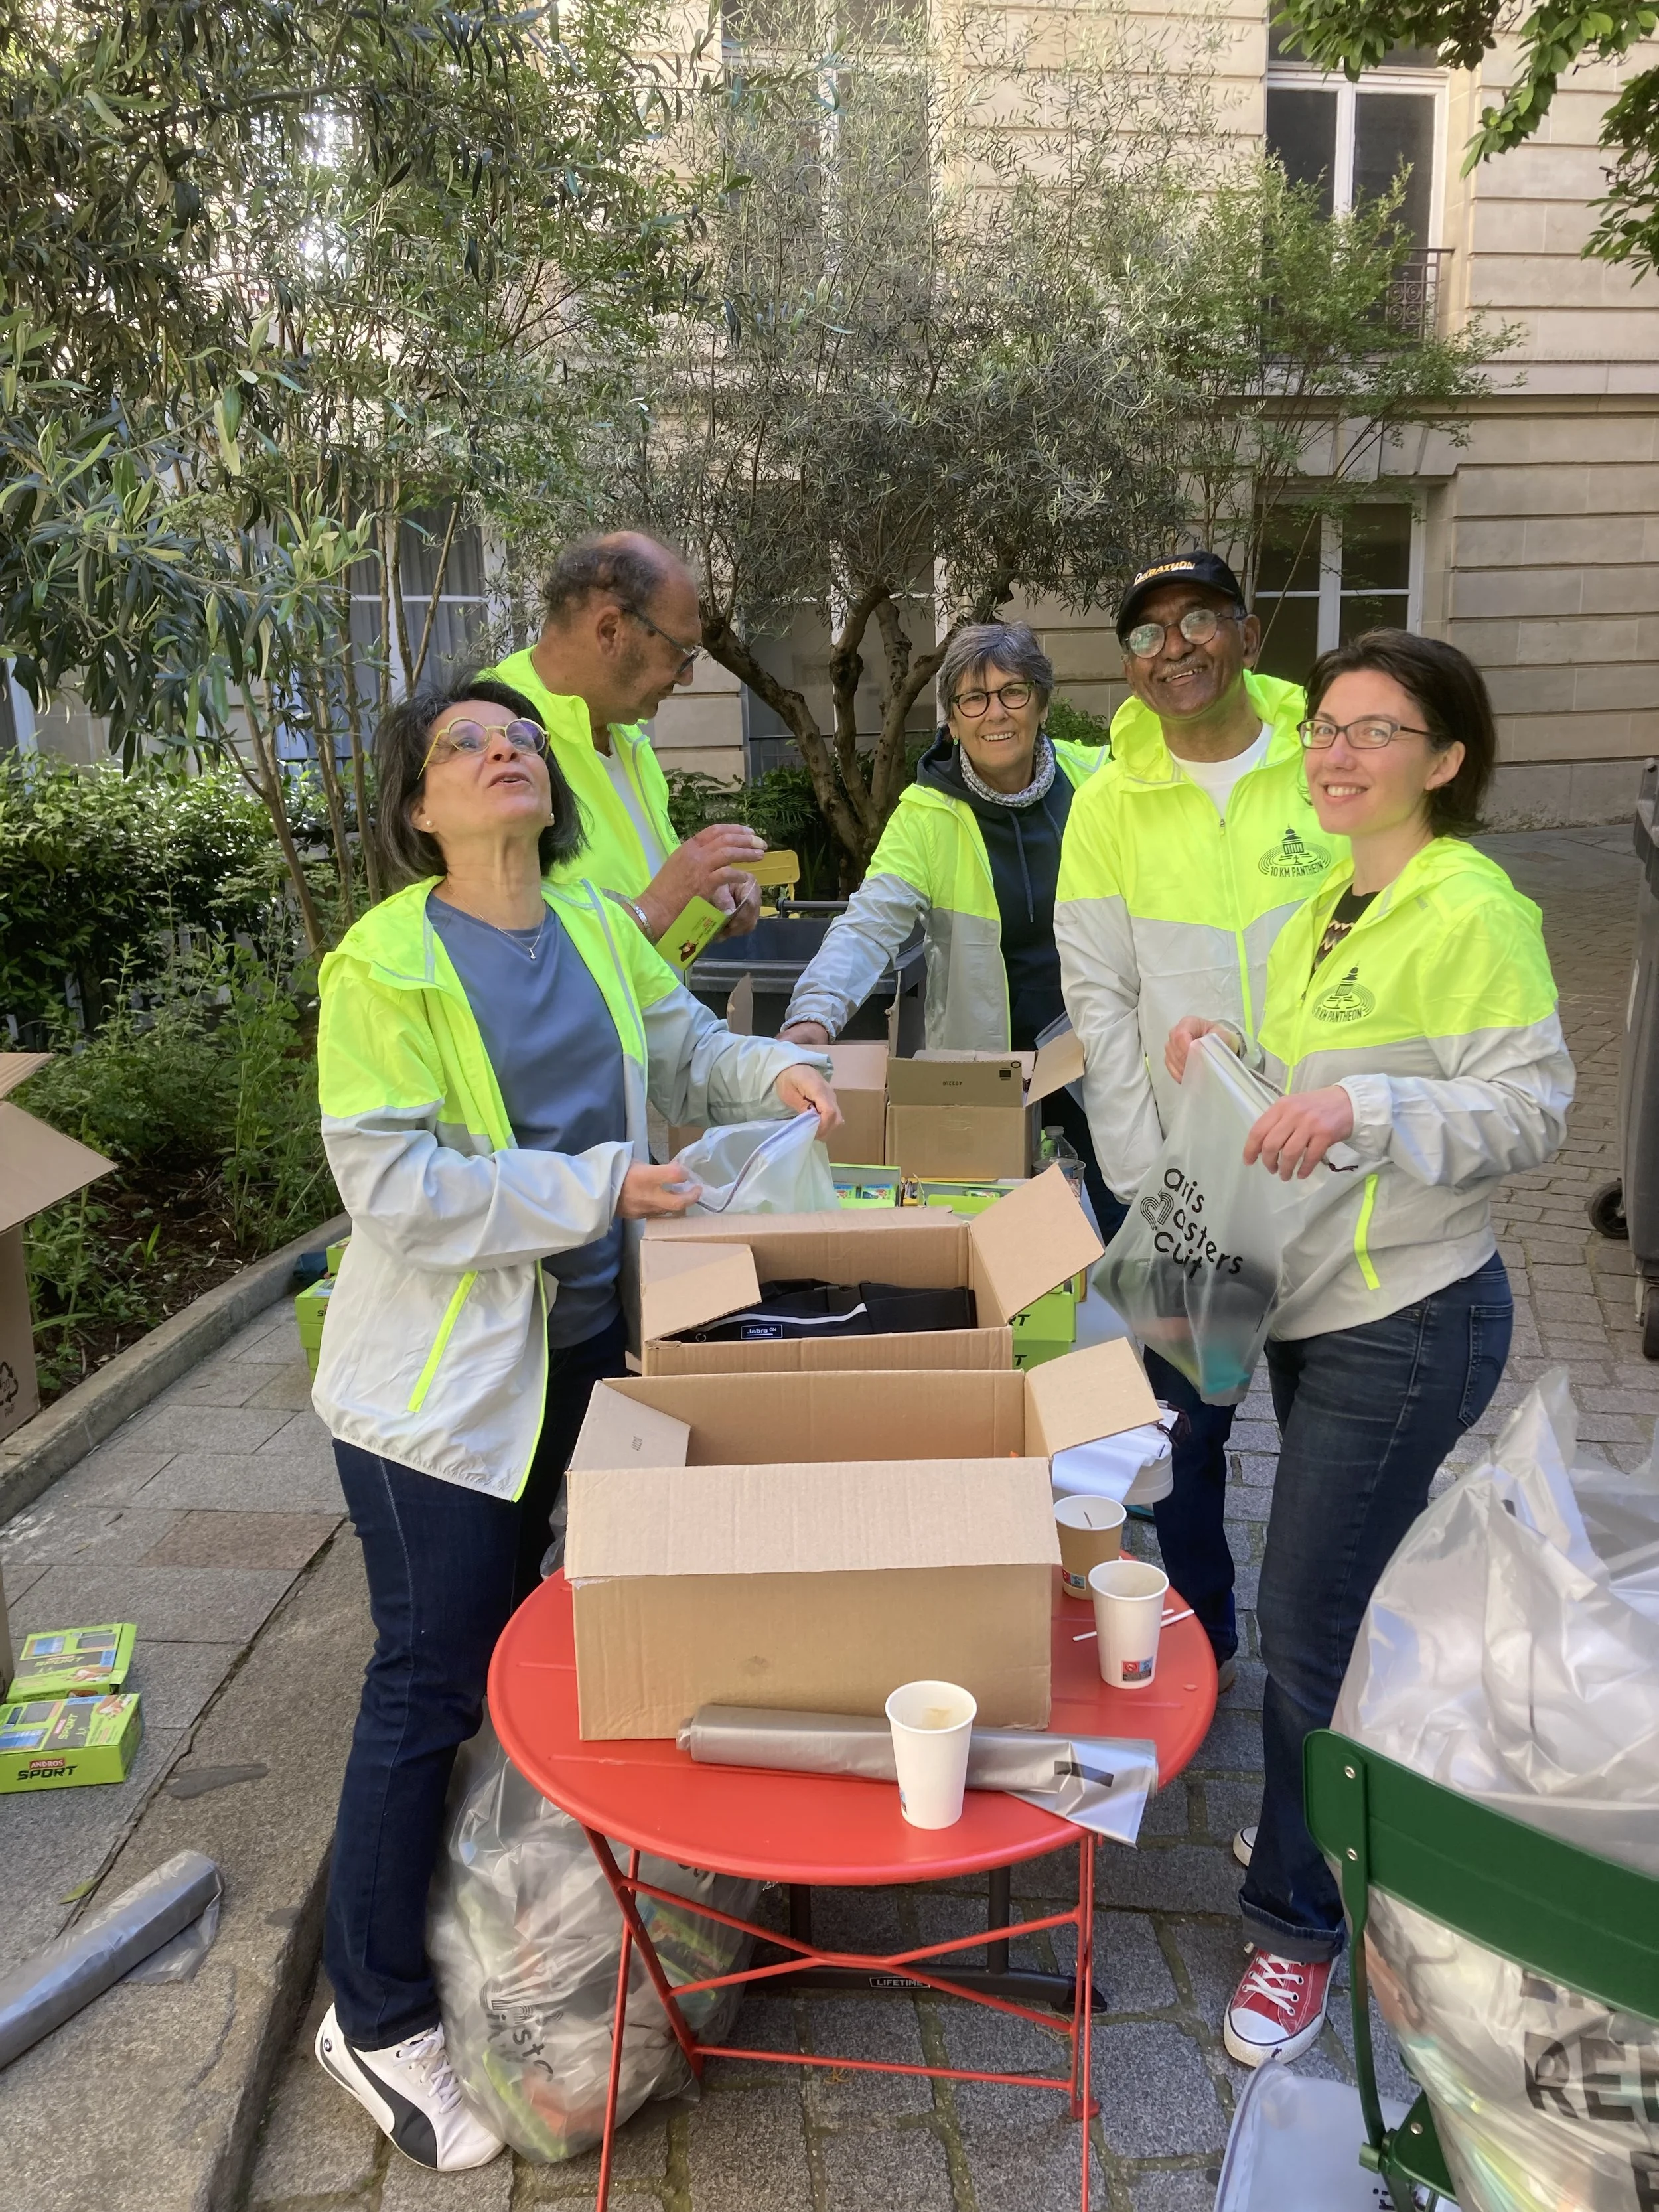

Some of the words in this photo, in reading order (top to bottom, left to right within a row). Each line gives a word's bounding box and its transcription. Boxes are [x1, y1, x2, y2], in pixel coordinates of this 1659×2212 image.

[1270, 866, 1279, 877] 10
[1279, 867, 1291, 877] KM
[17, 1765, 78, 1781] SPORT
